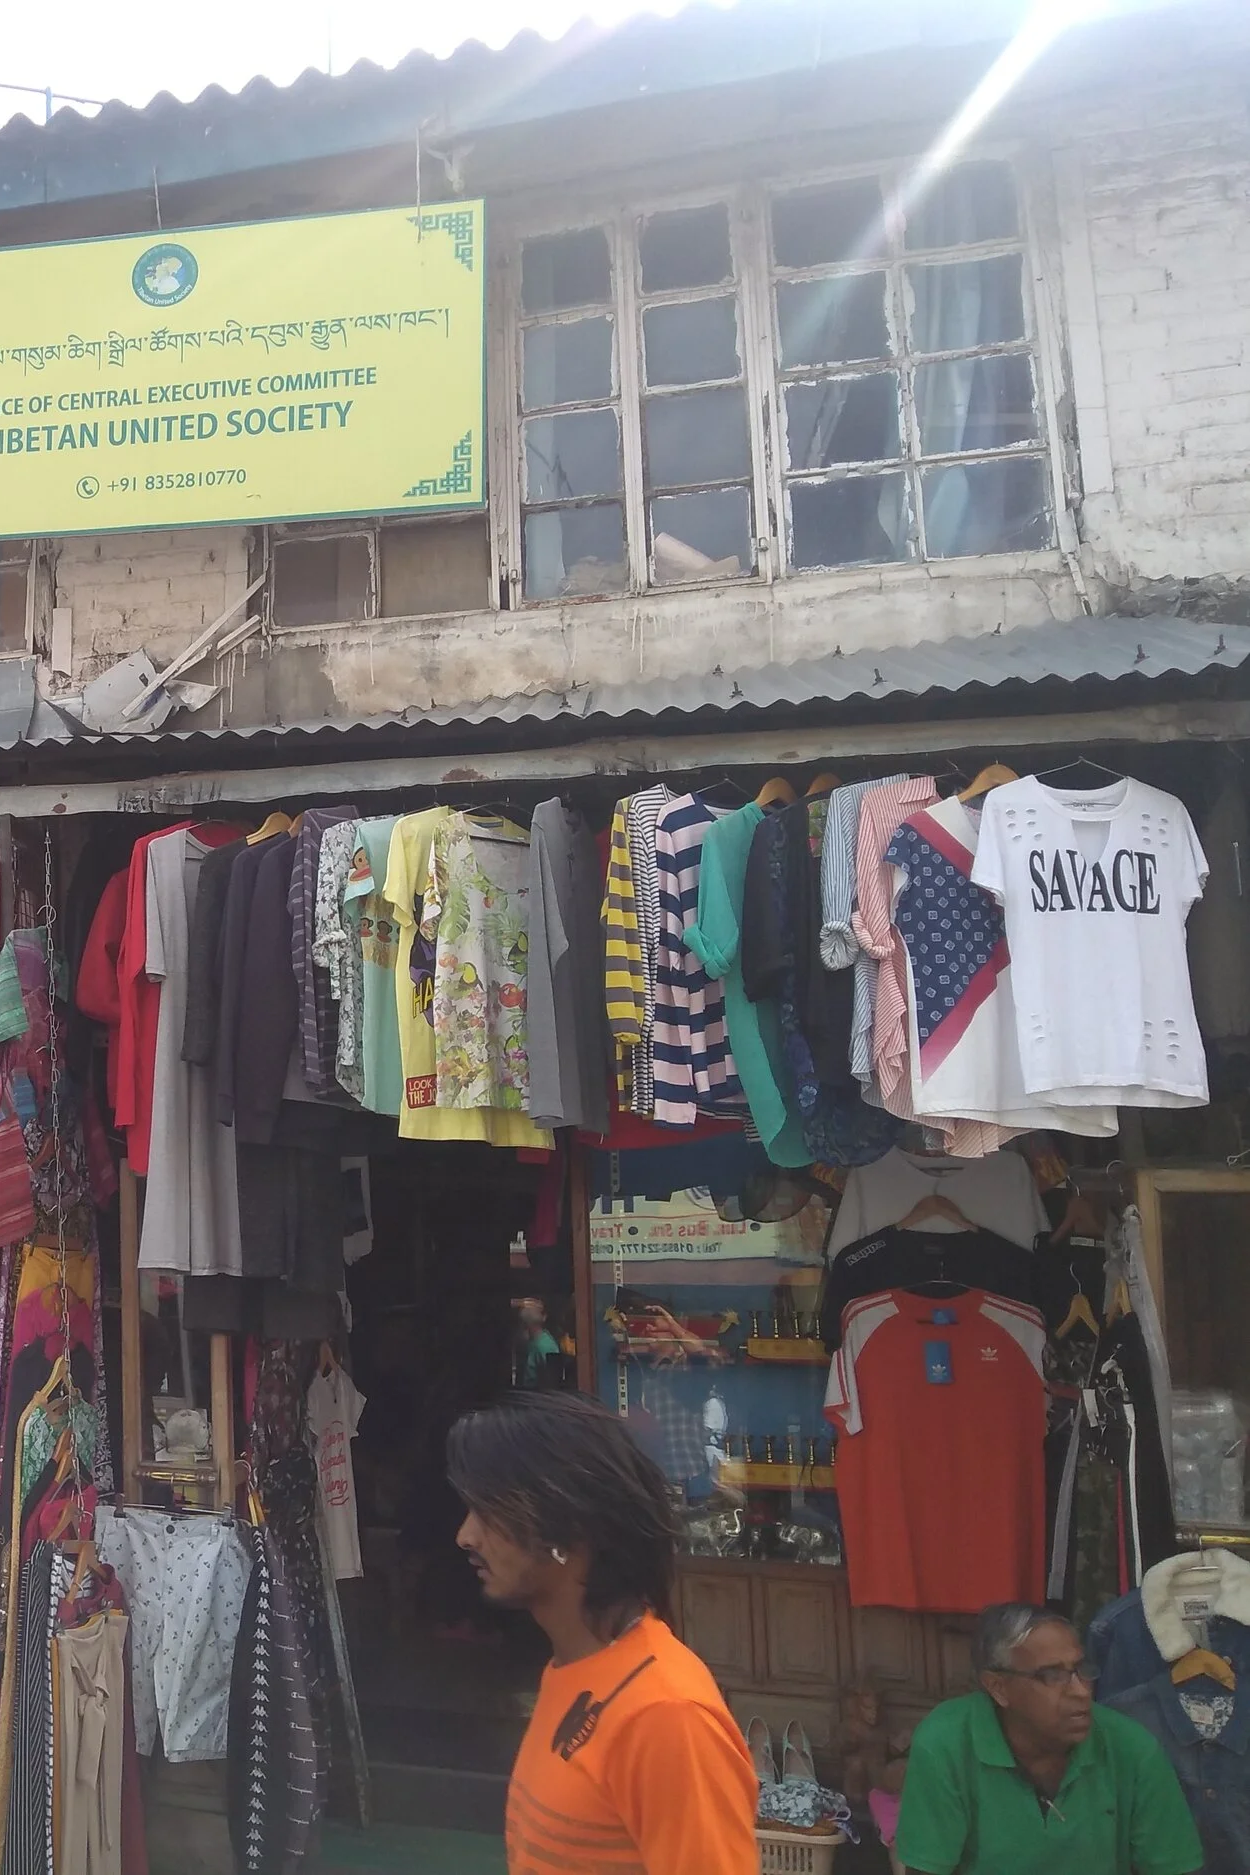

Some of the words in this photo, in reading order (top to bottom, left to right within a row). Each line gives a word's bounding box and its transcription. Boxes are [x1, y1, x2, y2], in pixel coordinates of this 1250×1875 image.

[28, 393, 54, 414] OF
[57, 386, 142, 412] CENTRAL
[148, 378, 252, 406] EXECUTIVE
[256, 366, 377, 394] COMMITTEE
[107, 412, 218, 447] UNITED
[226, 400, 354, 438] SOCIETY
[106, 474, 138, 493] +91
[145, 468, 247, 491] 8352810770
[1029, 848, 1161, 915] SAVAGE
[408, 1090, 426, 1106] THE
[409, 1079, 433, 1092] LOOK
